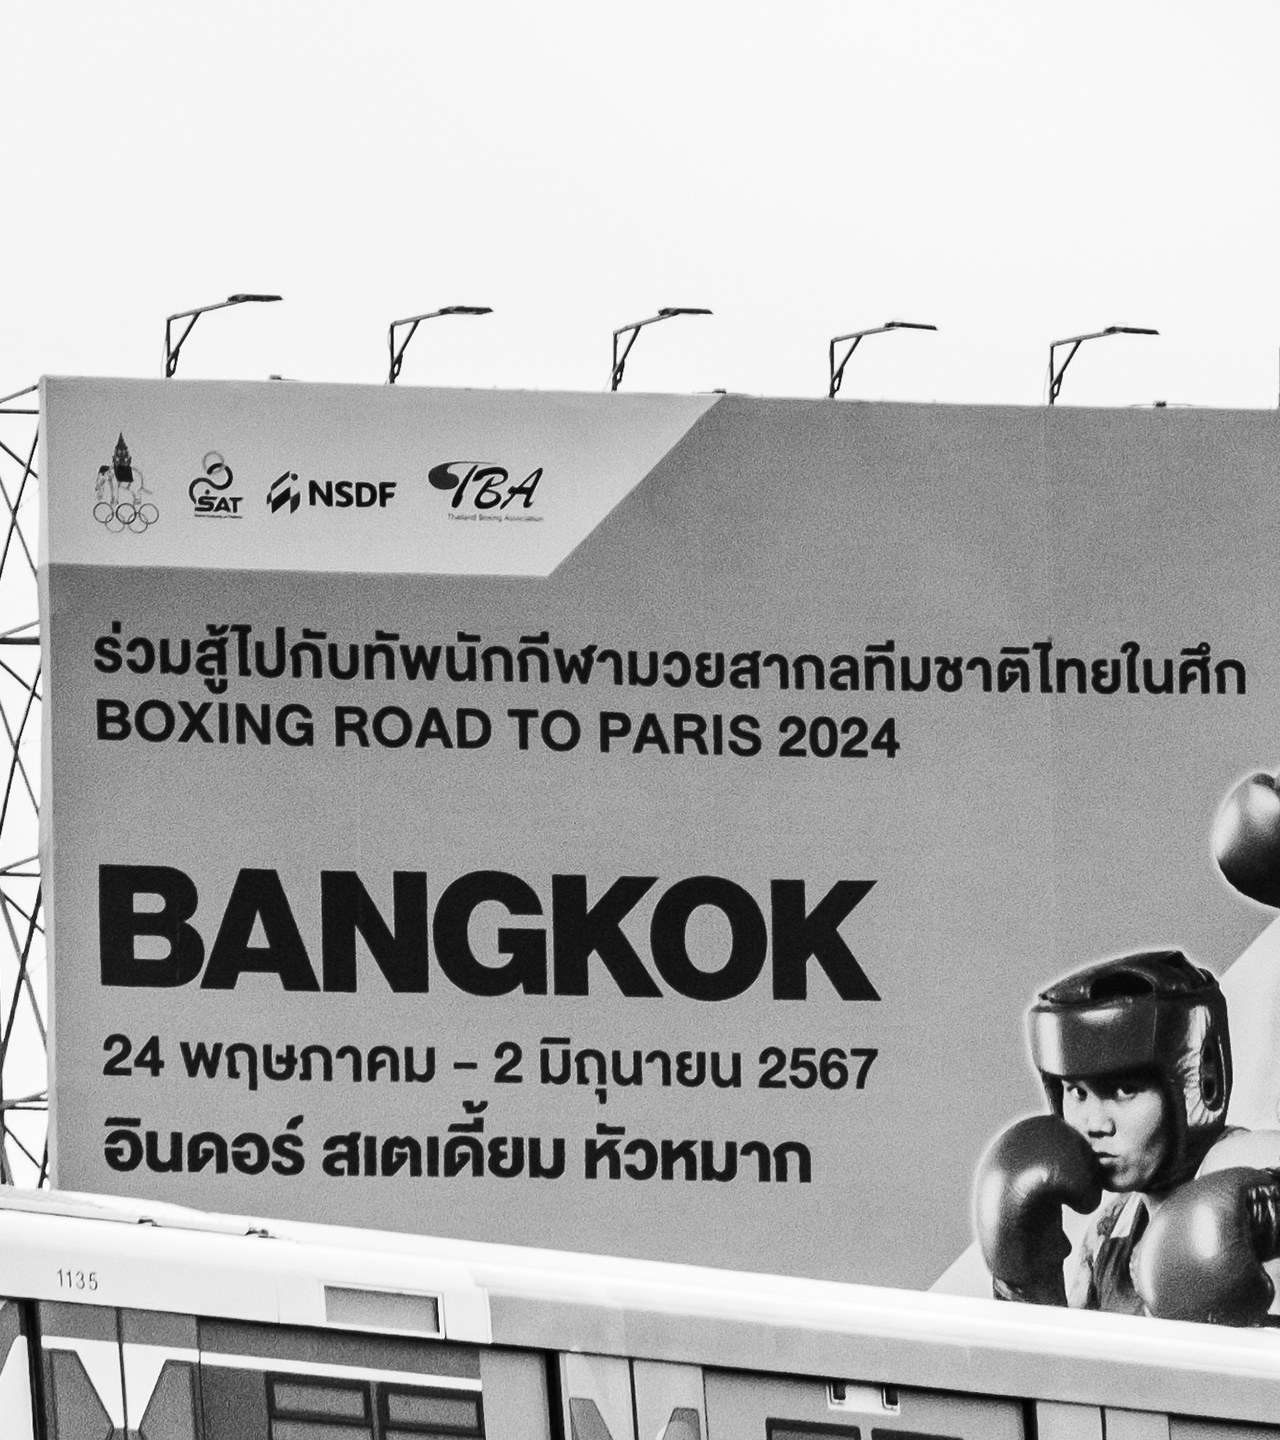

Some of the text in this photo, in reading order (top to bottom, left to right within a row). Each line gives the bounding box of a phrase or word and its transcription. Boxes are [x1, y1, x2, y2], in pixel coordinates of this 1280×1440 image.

[195, 494, 243, 513] SAT
[308, 480, 397, 509] NSDF
[428, 460, 543, 510] TBA
[94, 621, 1247, 694] ร่วมสู้ไปกับทัพนักกีฬามวยสากลทีมชาติไทยในศึก
[96, 699, 900, 759] BOXING ROAD TO PARIS 2024
[98, 863, 882, 1002] BANGKOK
[102, 1034, 165, 1078] 24
[180, 1038, 437, 1092] พฤษภาคม
[493, 1040, 523, 1083] 2
[539, 1036, 743, 1105] มิถุนายน
[758, 1047, 880, 1091] 2567
[103, 1101, 812, 1185] อินดอร์ สเตเดี้ยม หัวหมาก
[57, 1268, 98, 1291] 1135
